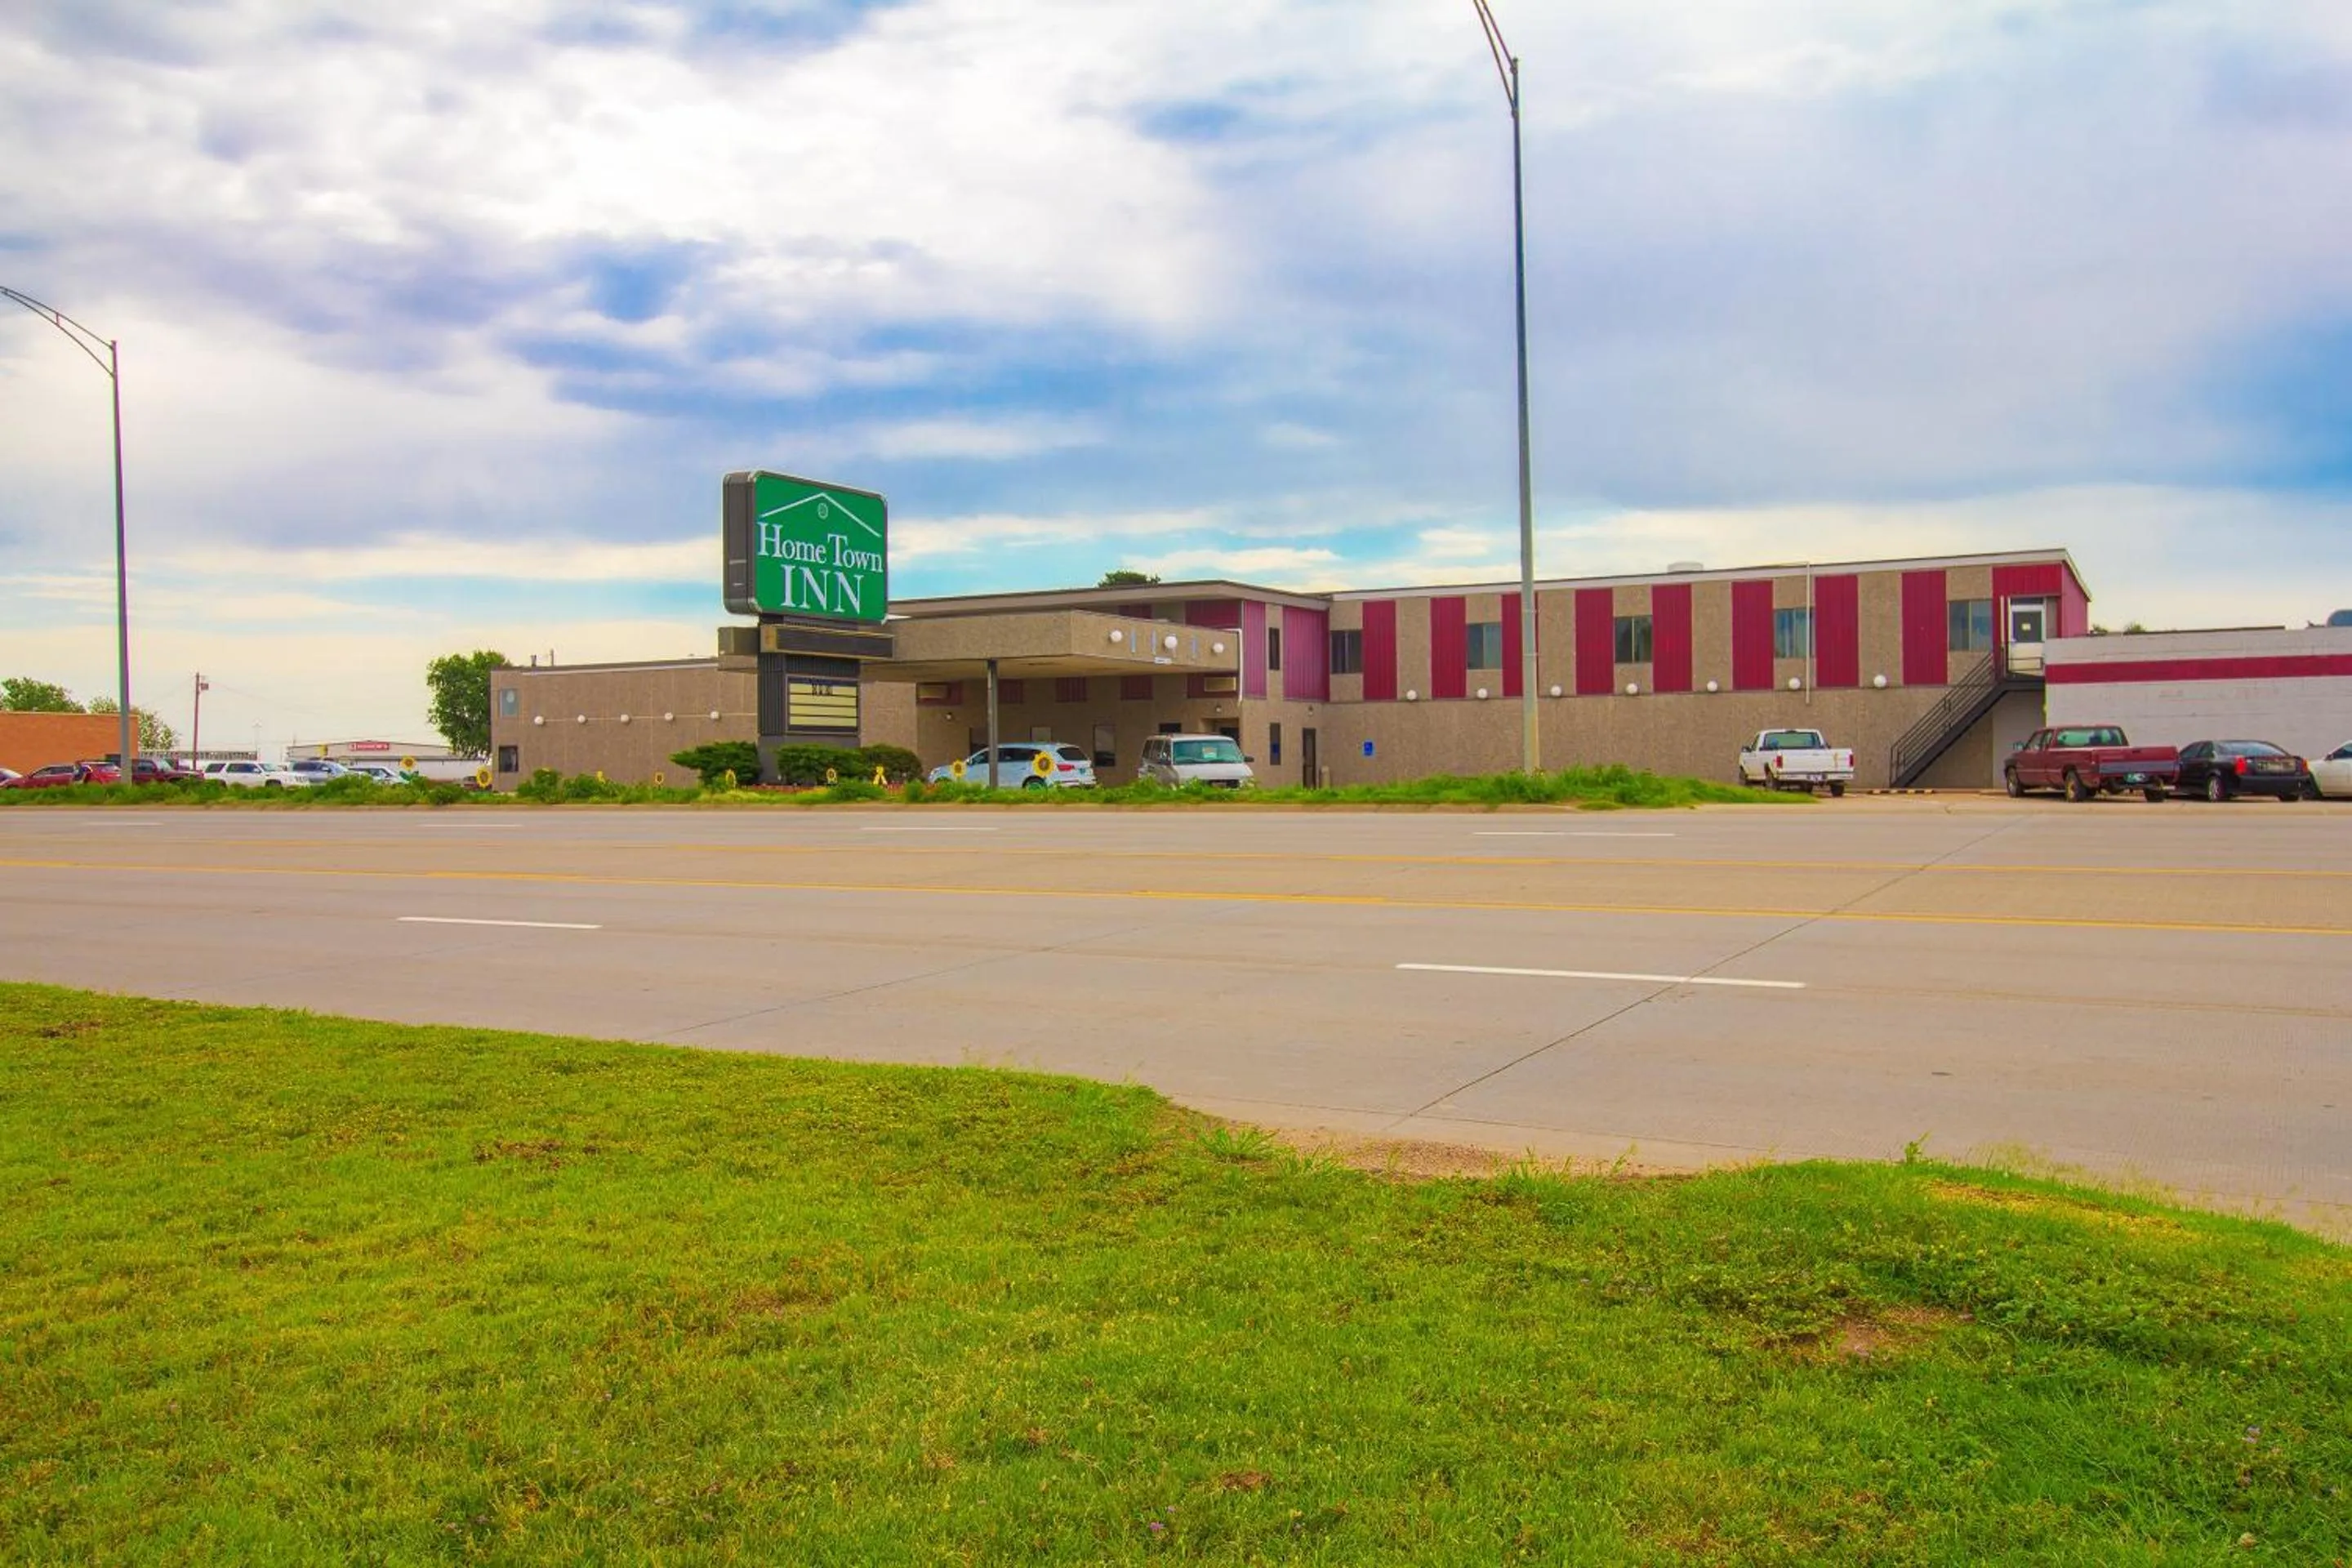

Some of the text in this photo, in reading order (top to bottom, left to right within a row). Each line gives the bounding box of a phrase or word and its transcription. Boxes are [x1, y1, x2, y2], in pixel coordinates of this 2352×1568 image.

[757, 522, 883, 572] Home Town
[781, 564, 864, 614] INN
